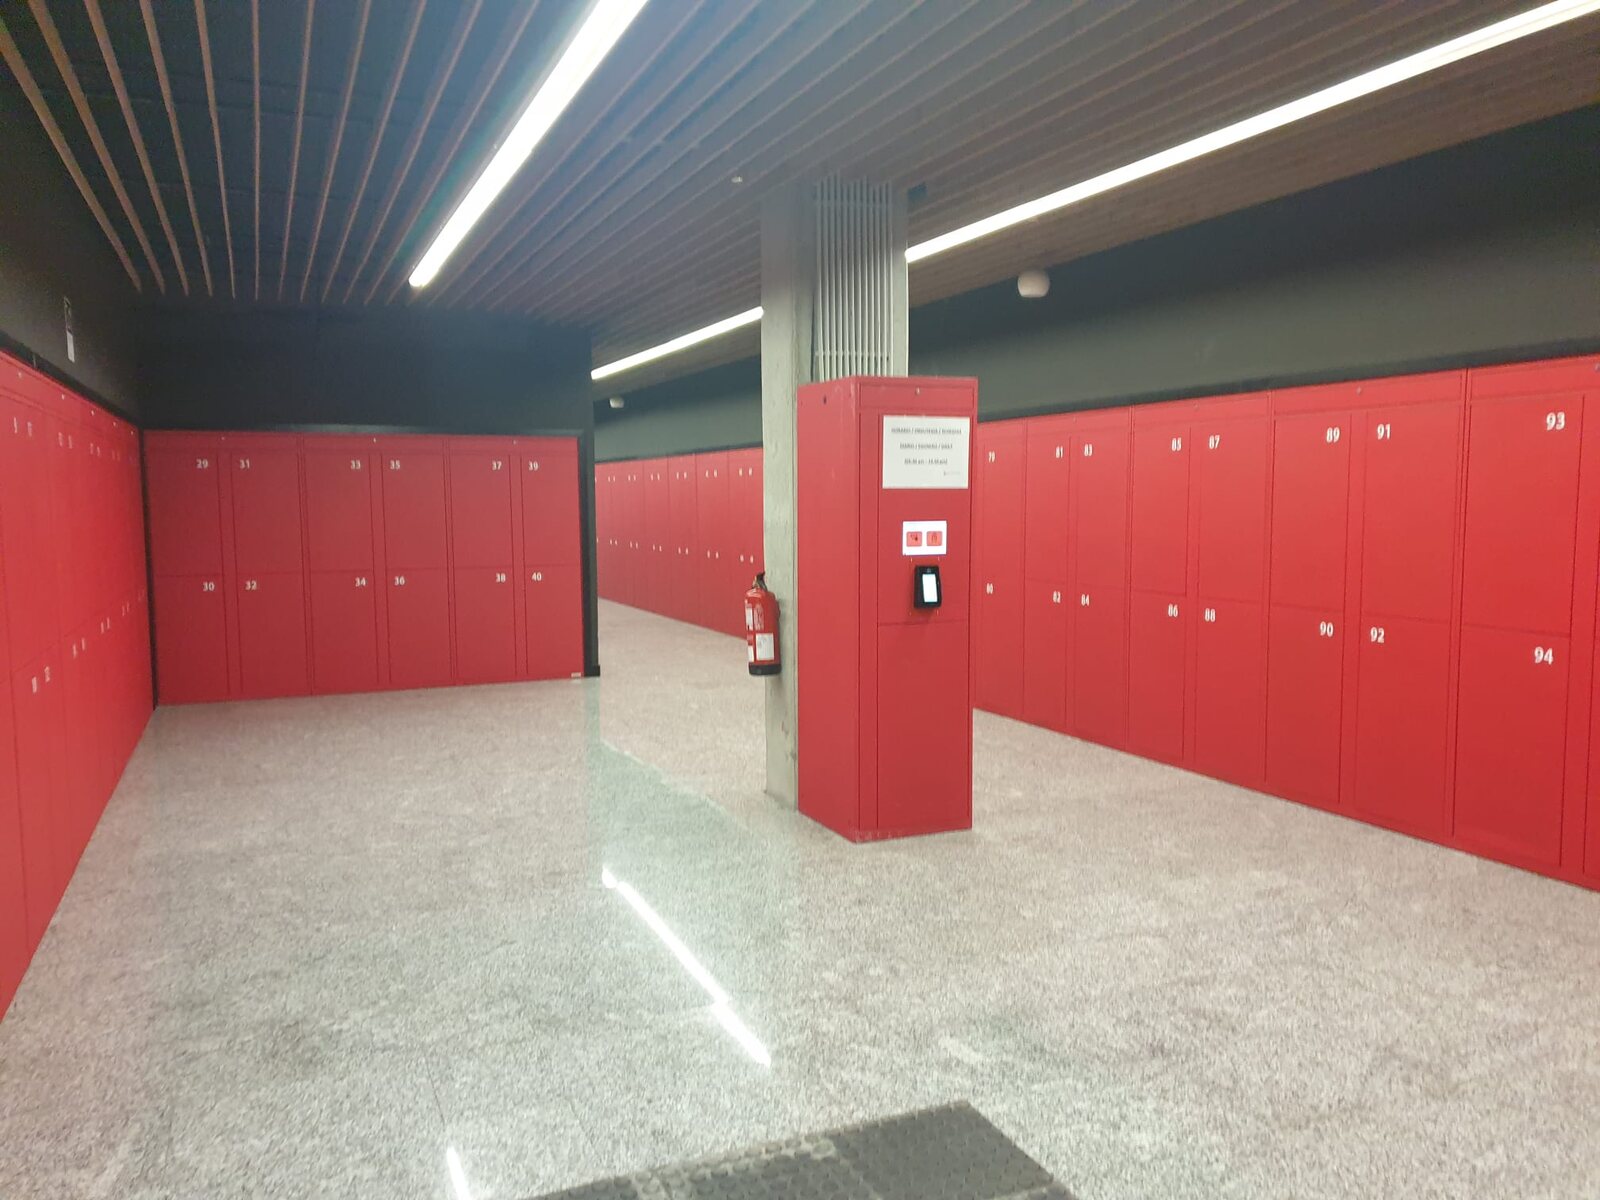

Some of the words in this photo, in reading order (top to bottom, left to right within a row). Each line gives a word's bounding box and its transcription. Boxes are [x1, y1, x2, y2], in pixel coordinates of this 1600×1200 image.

[1545, 411, 1566, 431] 93
[1326, 426, 1341, 443] 89
[1376, 423, 1391, 440] 91
[1208, 434, 1220, 450] 87
[239, 458, 250, 469] 31
[390, 459, 401, 470] 35
[492, 460, 502, 471] 37
[355, 577, 367, 587] 34
[394, 575, 406, 586] 36
[531, 571, 542, 582] 40
[203, 581, 216, 592] 30
[245, 580, 258, 591] 32
[1167, 603, 1179, 618] 86
[1319, 621, 1334, 638] 90
[1370, 626, 1385, 644] 92
[1534, 646, 1554, 665] 94
